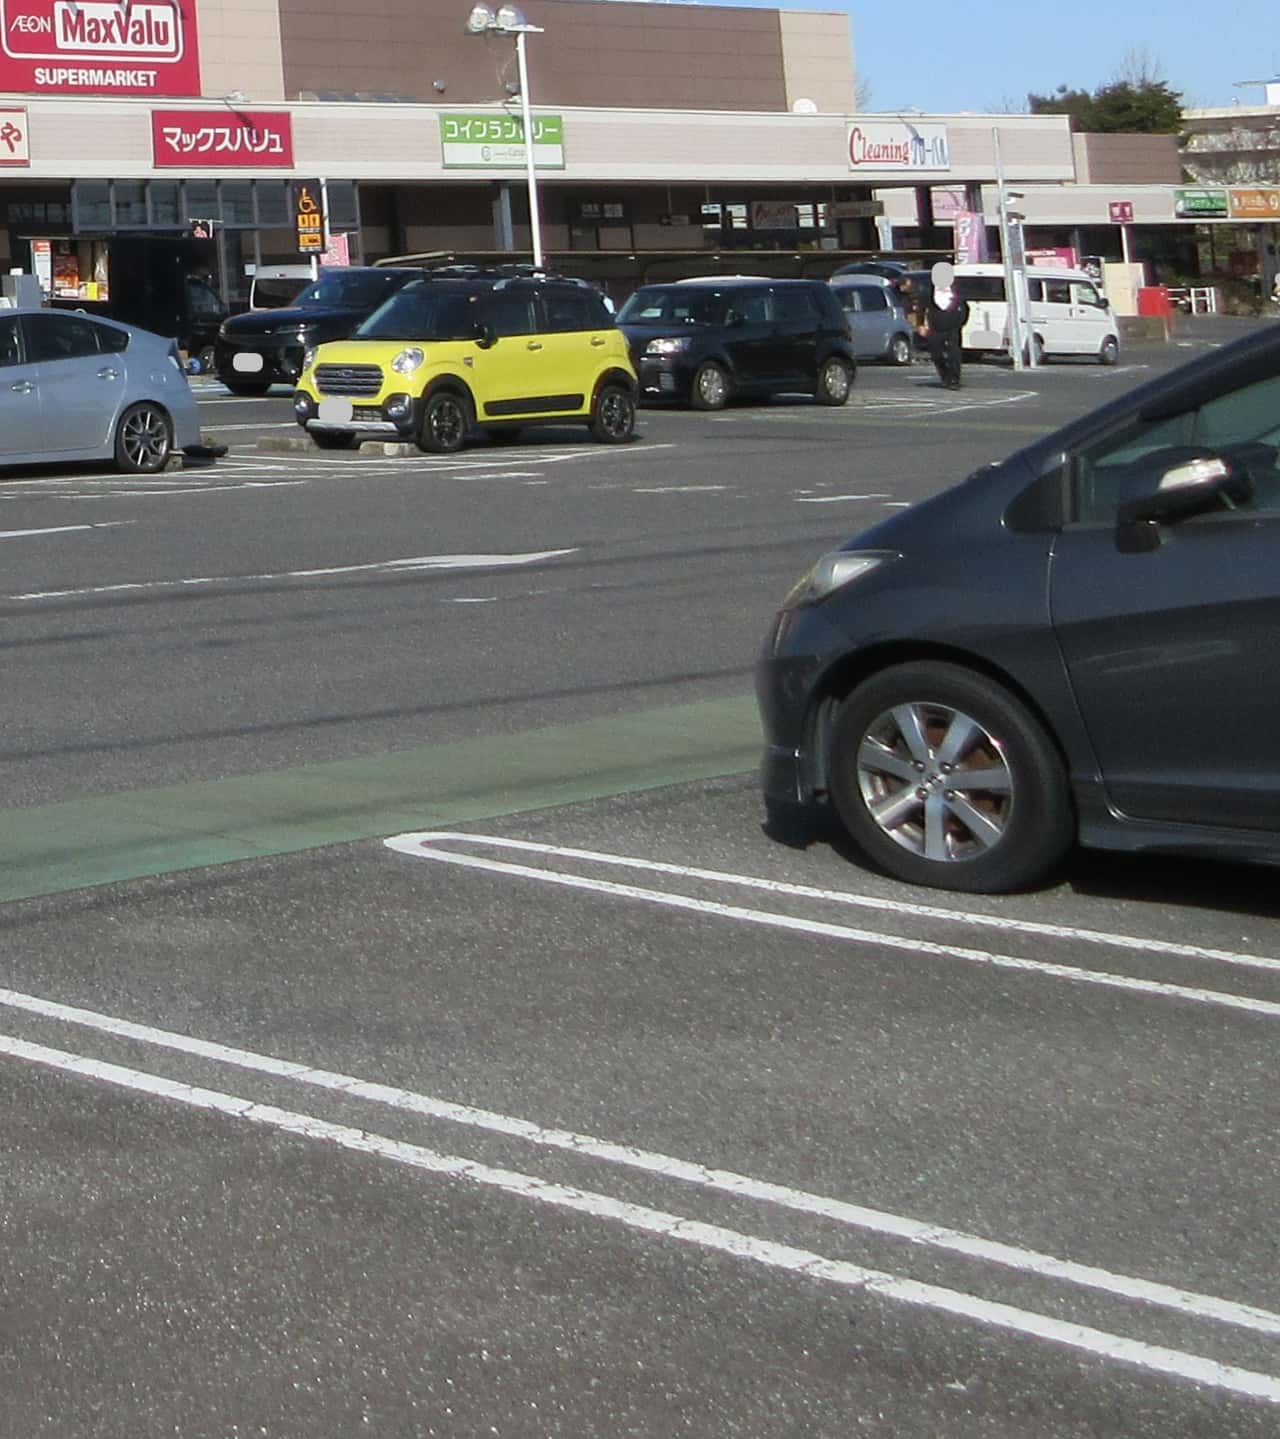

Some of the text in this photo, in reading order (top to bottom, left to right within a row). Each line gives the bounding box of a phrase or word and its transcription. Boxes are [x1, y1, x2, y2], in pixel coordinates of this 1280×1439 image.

[34, 68, 157, 87] SUPERMARKET
[162, 127, 284, 153] マックスバリュ
[849, 127, 909, 165] Cleaning
